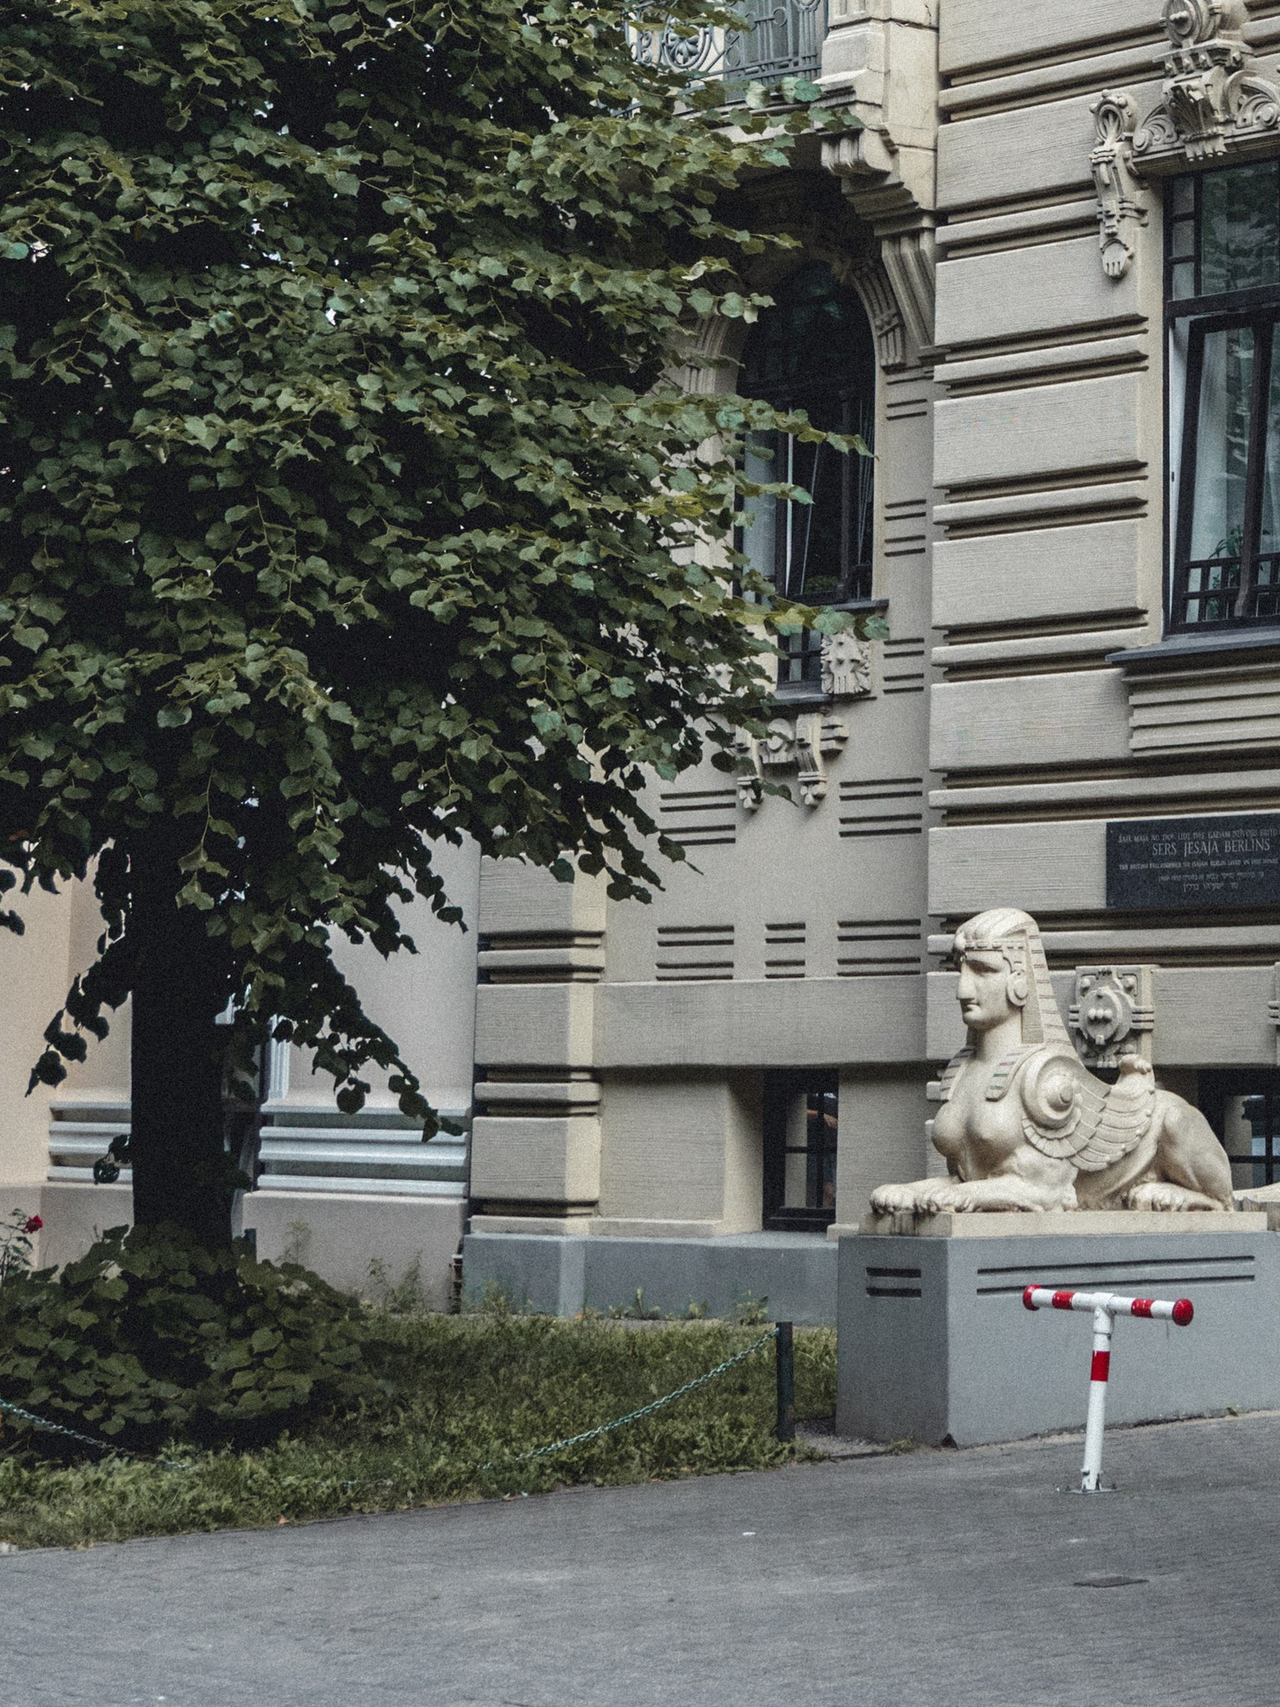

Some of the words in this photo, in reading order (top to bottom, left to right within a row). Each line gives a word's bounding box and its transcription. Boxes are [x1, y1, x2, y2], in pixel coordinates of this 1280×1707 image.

[1152, 842, 1177, 856] SERS
[1184, 839, 1219, 858] JESAJA
[1224, 838, 1270, 854] BERLINS
